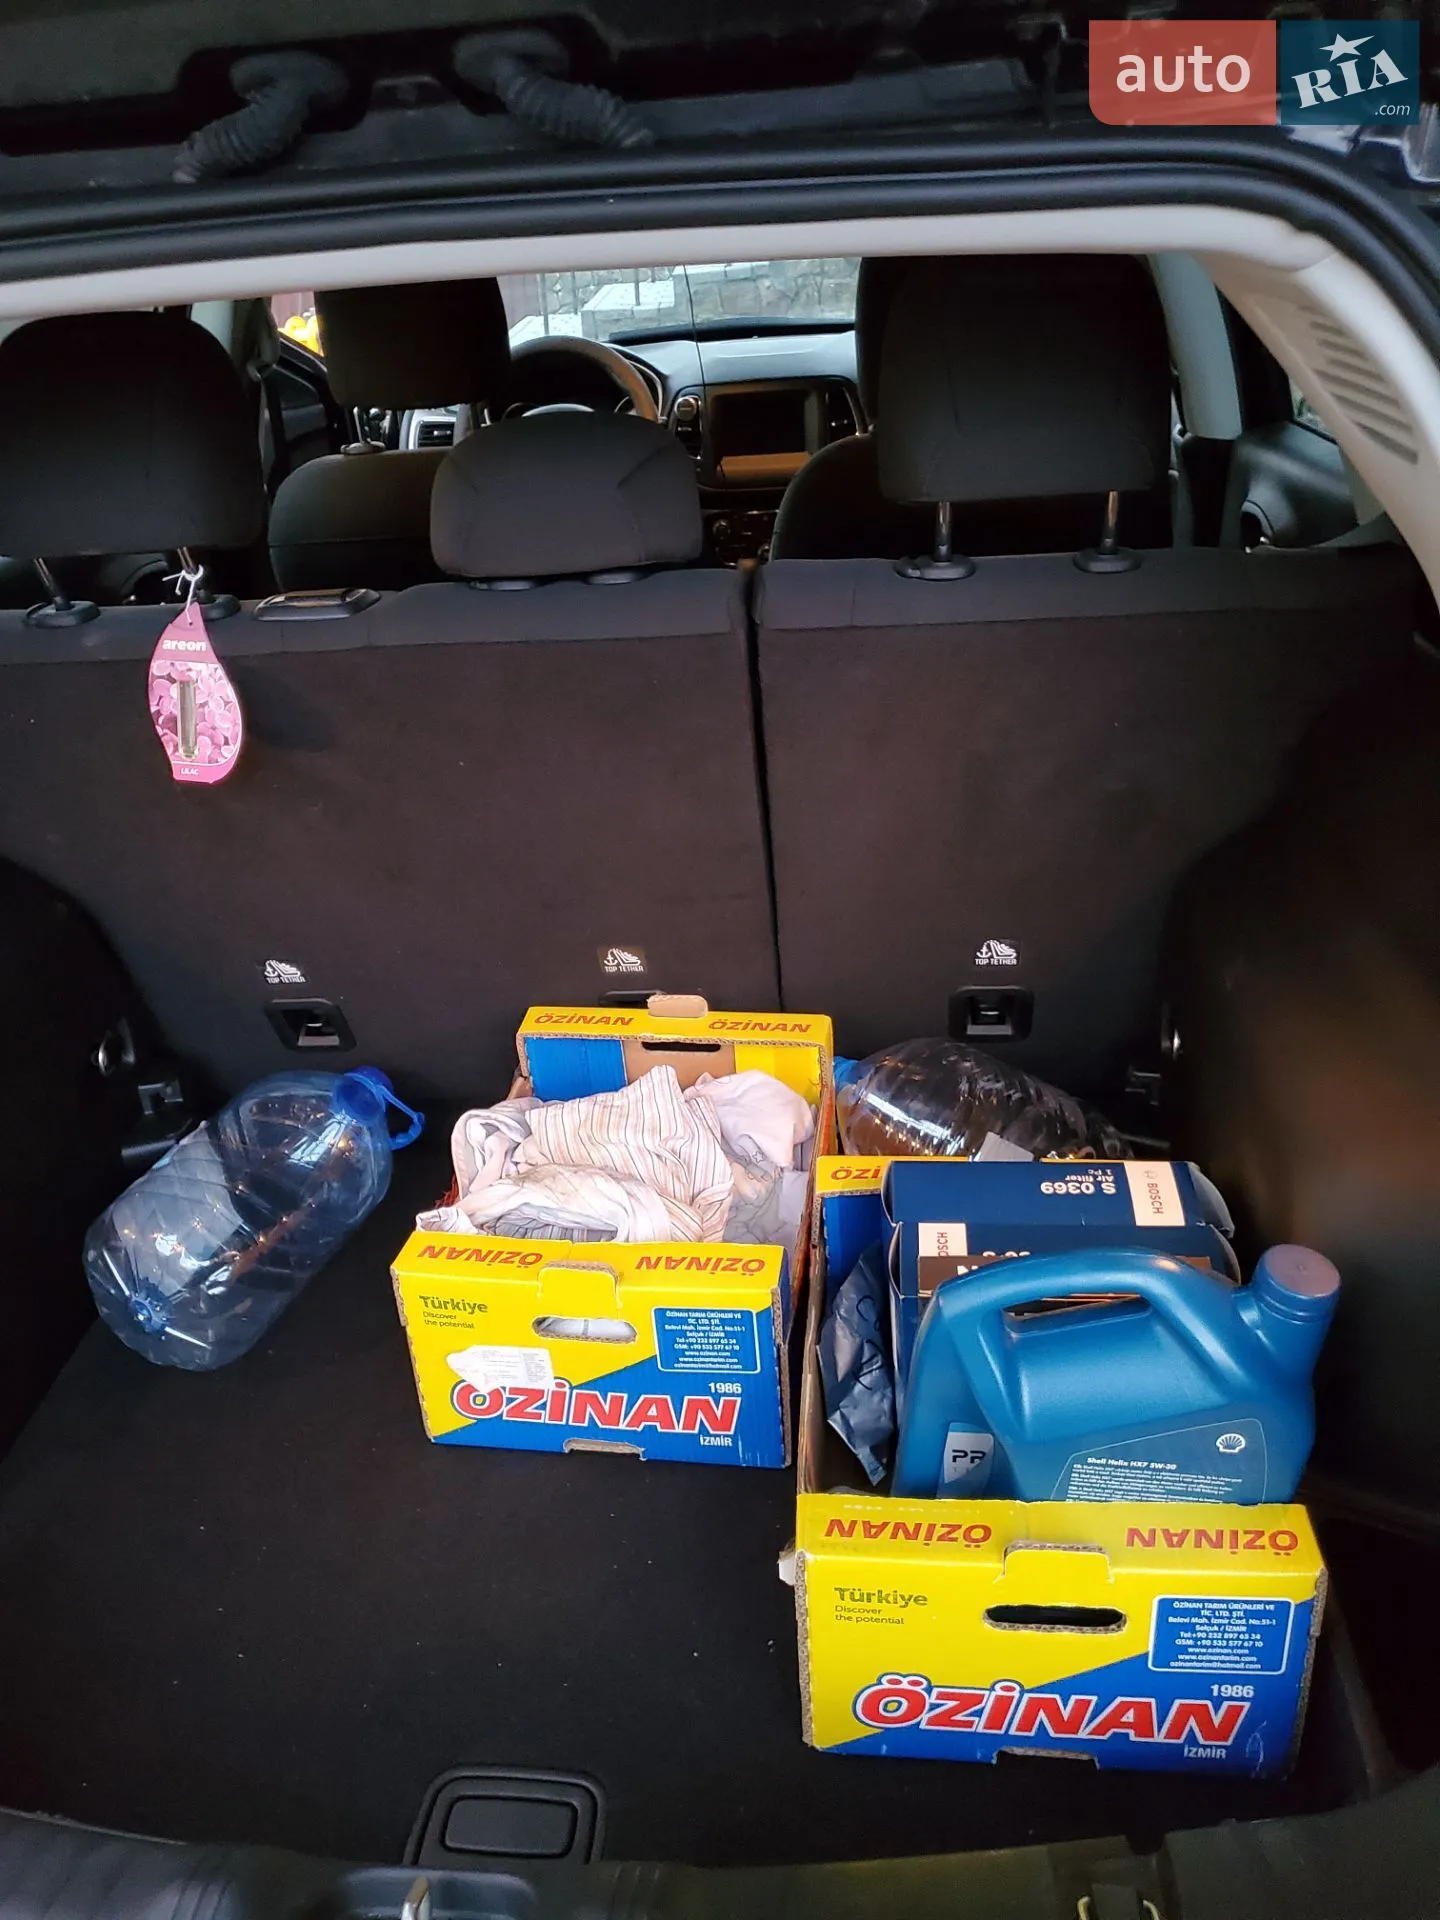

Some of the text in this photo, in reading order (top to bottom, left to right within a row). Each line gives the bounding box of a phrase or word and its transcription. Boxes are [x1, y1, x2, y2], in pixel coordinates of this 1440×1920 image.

[162, 639, 207, 651] areon
[534, 1012, 634, 1027] ÖZİNAN
[708, 1018, 813, 1034] ÖZİNAN
[1096, 1175, 1114, 1183] Air
[1040, 1181, 1117, 1195] S 0369
[1147, 1182, 1164, 1214] BOSCH
[417, 1245, 544, 1269] ÖZİNAN
[635, 1256, 766, 1277] ÖZİNAN
[419, 1295, 489, 1315] Türkiye
[422, 1311, 457, 1320] Discover
[424, 1319, 476, 1330] the potential
[708, 1382, 743, 1395] 1986
[700, 1434, 733, 1448] İZMİR
[1087, 1457, 1177, 1470] Shell Helix HX7 5W-30
[824, 1518, 992, 1549] ÖZİNAN
[1126, 1527, 1299, 1557] ÖZİNAN
[834, 1587, 928, 1609] Türkiye
[834, 1605, 883, 1616] Discover
[1173, 1601, 1203, 1609] ÖZİNAN
[1204, 1602, 1228, 1610] TARIM
[1228, 1602, 1265, 1611] ÜRÜNLERİ
[835, 1614, 905, 1626] the potential
[1191, 1616, 1210, 1624] Mah.
[1215, 1610, 1231, 1618] LTD.
[1195, 1624, 1220, 1632] Selçuk
[1196, 1639, 1212, 1647] +90
[1228, 1640, 1243, 1648] 577
[1254, 1641, 1264, 1649] 10
[1188, 1647, 1250, 1655] www.ozinan.com
[1210, 1683, 1255, 1699] 1986
[857, 1675, 1251, 1746] ÖZİNAN
[1183, 1743, 1228, 1760] İZMİR
